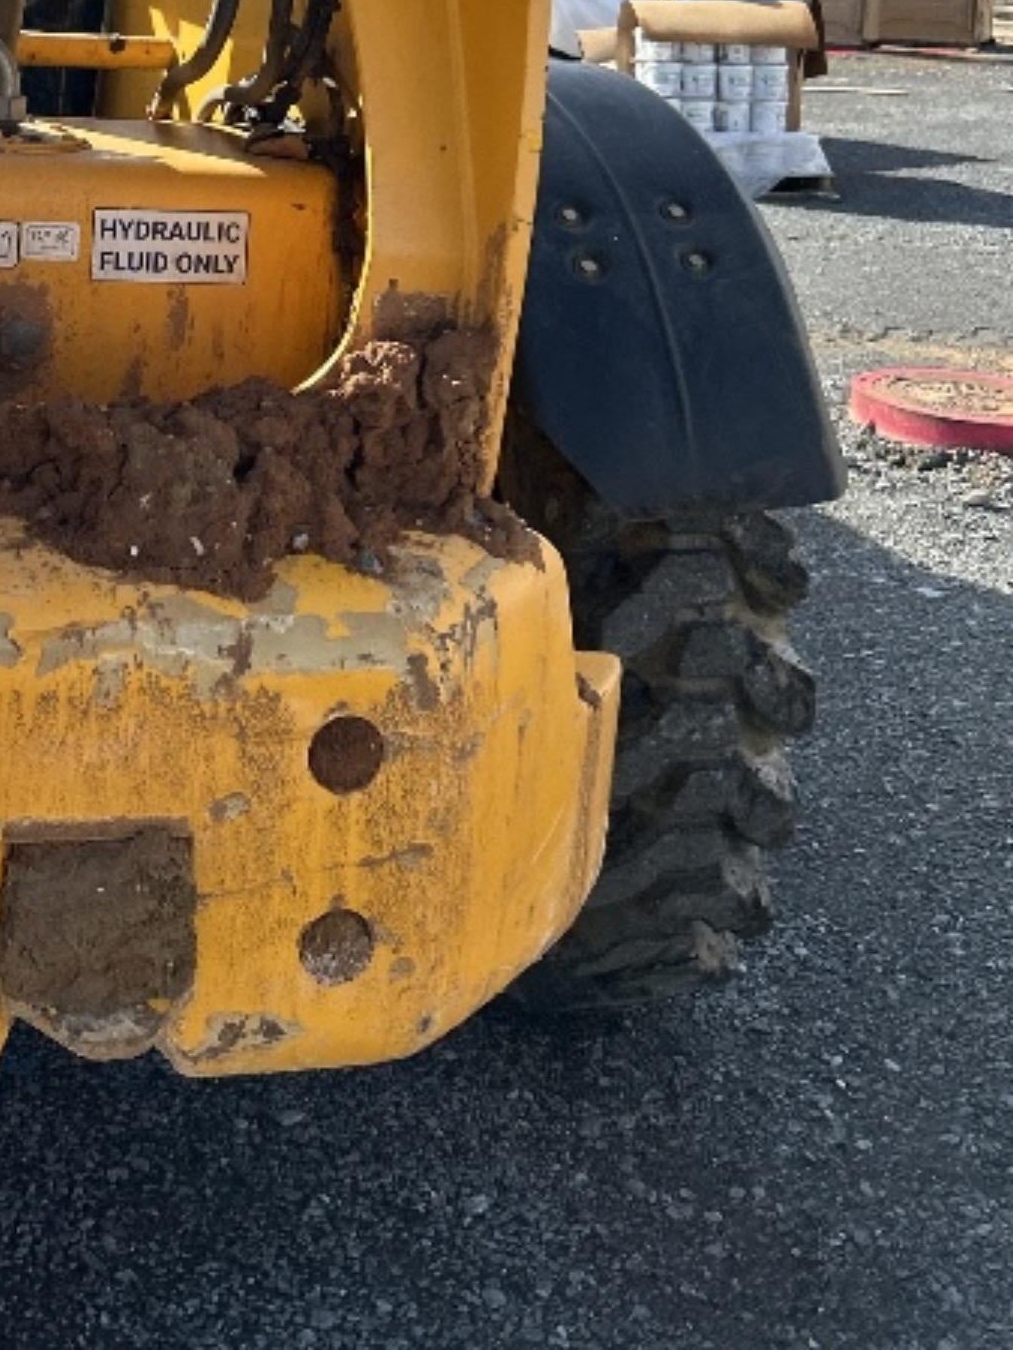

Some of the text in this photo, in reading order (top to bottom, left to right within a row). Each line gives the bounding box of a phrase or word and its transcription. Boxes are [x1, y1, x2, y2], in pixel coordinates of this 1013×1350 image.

[100, 218, 240, 243] HYDRAULIC
[100, 251, 240, 274] FLUID ONLY
